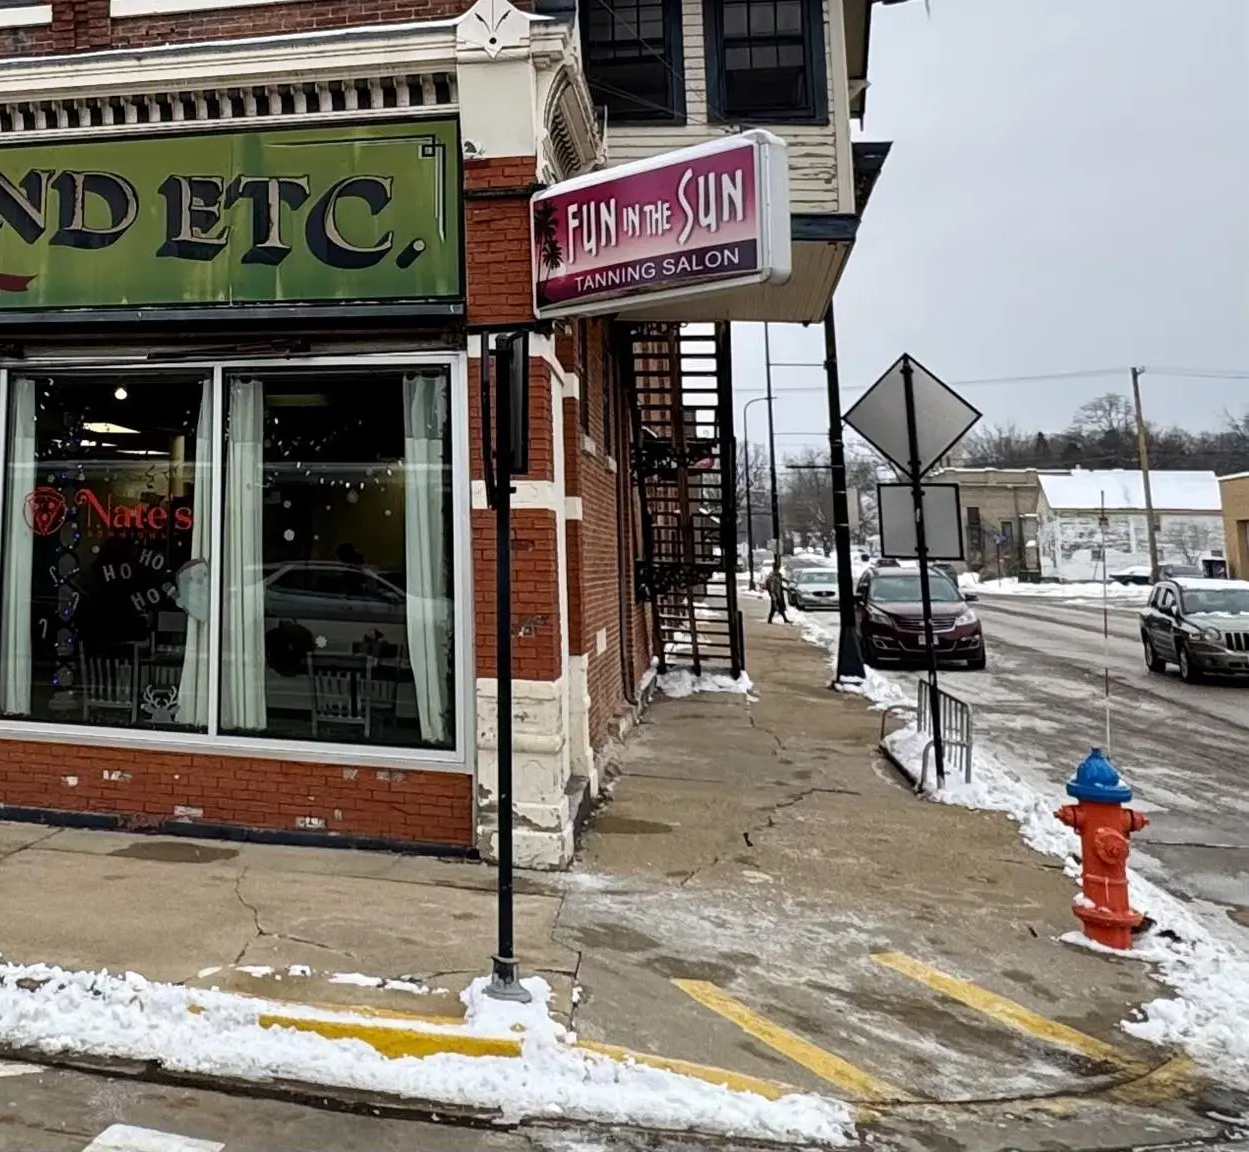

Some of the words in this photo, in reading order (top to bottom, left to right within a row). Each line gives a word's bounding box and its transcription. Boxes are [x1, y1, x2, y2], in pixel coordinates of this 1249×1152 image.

[158, 174, 427, 269] ETC.
[567, 198, 618, 264] FUN
[623, 203, 640, 236] IN
[643, 200, 672, 236] THE
[677, 168, 744, 246] SUN
[574, 262, 656, 293] TANNING
[662, 247, 740, 276] SALON
[102, 563, 132, 582] HO
[139, 548, 165, 570] HO
[130, 588, 161, 611] HO
